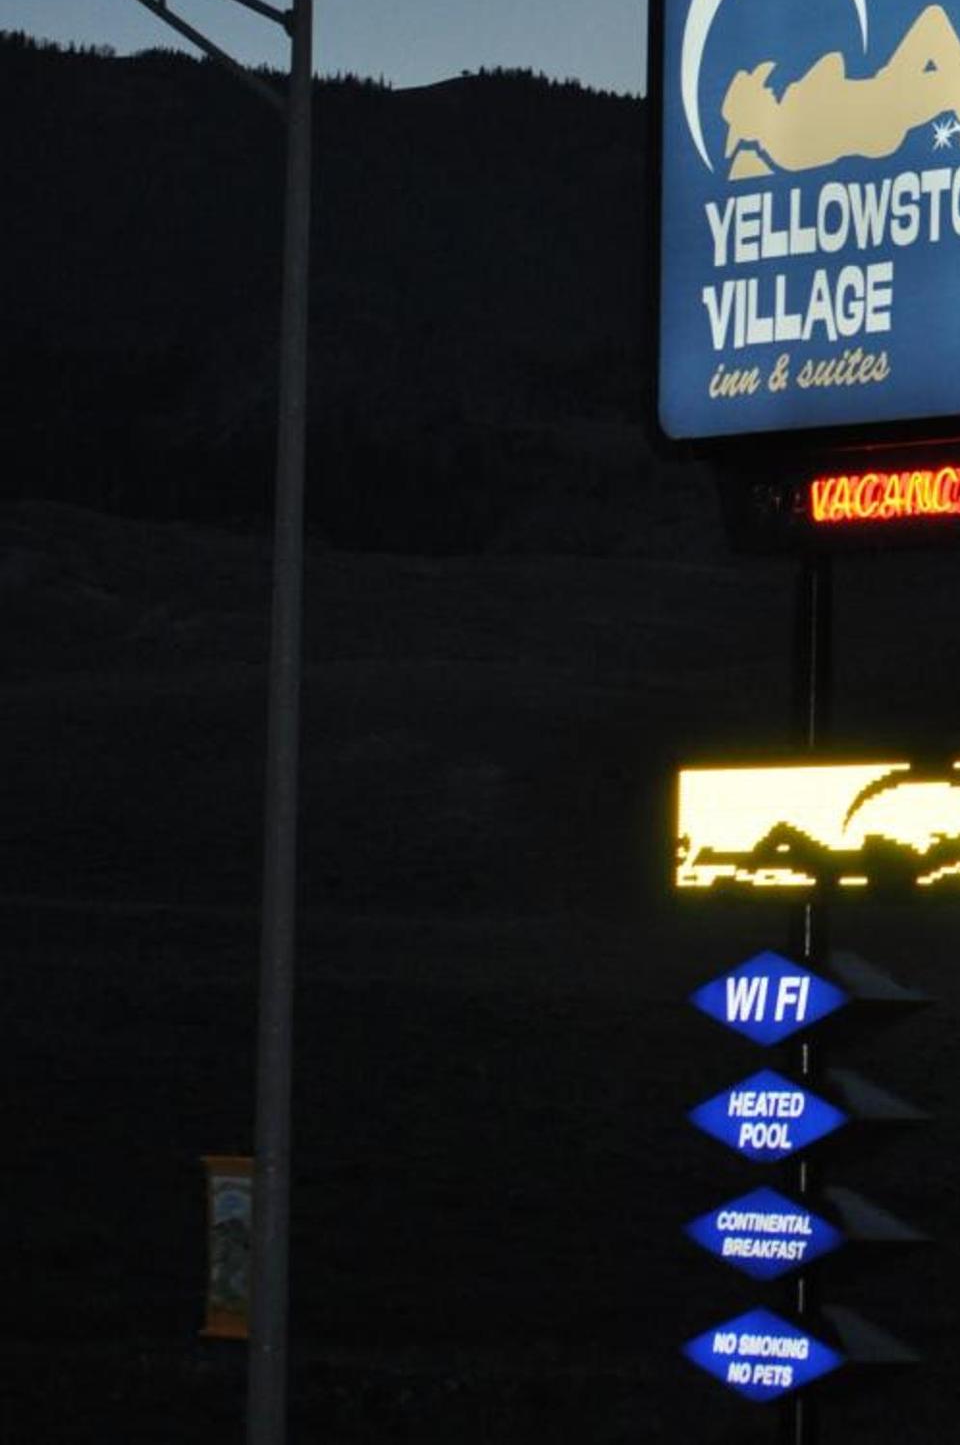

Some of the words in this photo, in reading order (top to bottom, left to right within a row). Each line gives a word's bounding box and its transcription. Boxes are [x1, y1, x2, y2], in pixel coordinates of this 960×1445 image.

[701, 261, 894, 351] VILLAGE
[709, 363, 761, 398] inn
[768, 353, 791, 391] &
[797, 347, 890, 388] suites
[727, 1091, 805, 1117] HEATED
[738, 1123, 792, 1149] POOL
[716, 1211, 812, 1235] CONTINENTAL
[721, 1237, 807, 1260] BREAKFAST
[713, 1332, 737, 1354] NO
[738, 1334, 809, 1360] SMOKING
[727, 1362, 750, 1384] NO
[753, 1364, 792, 1388] PETS
